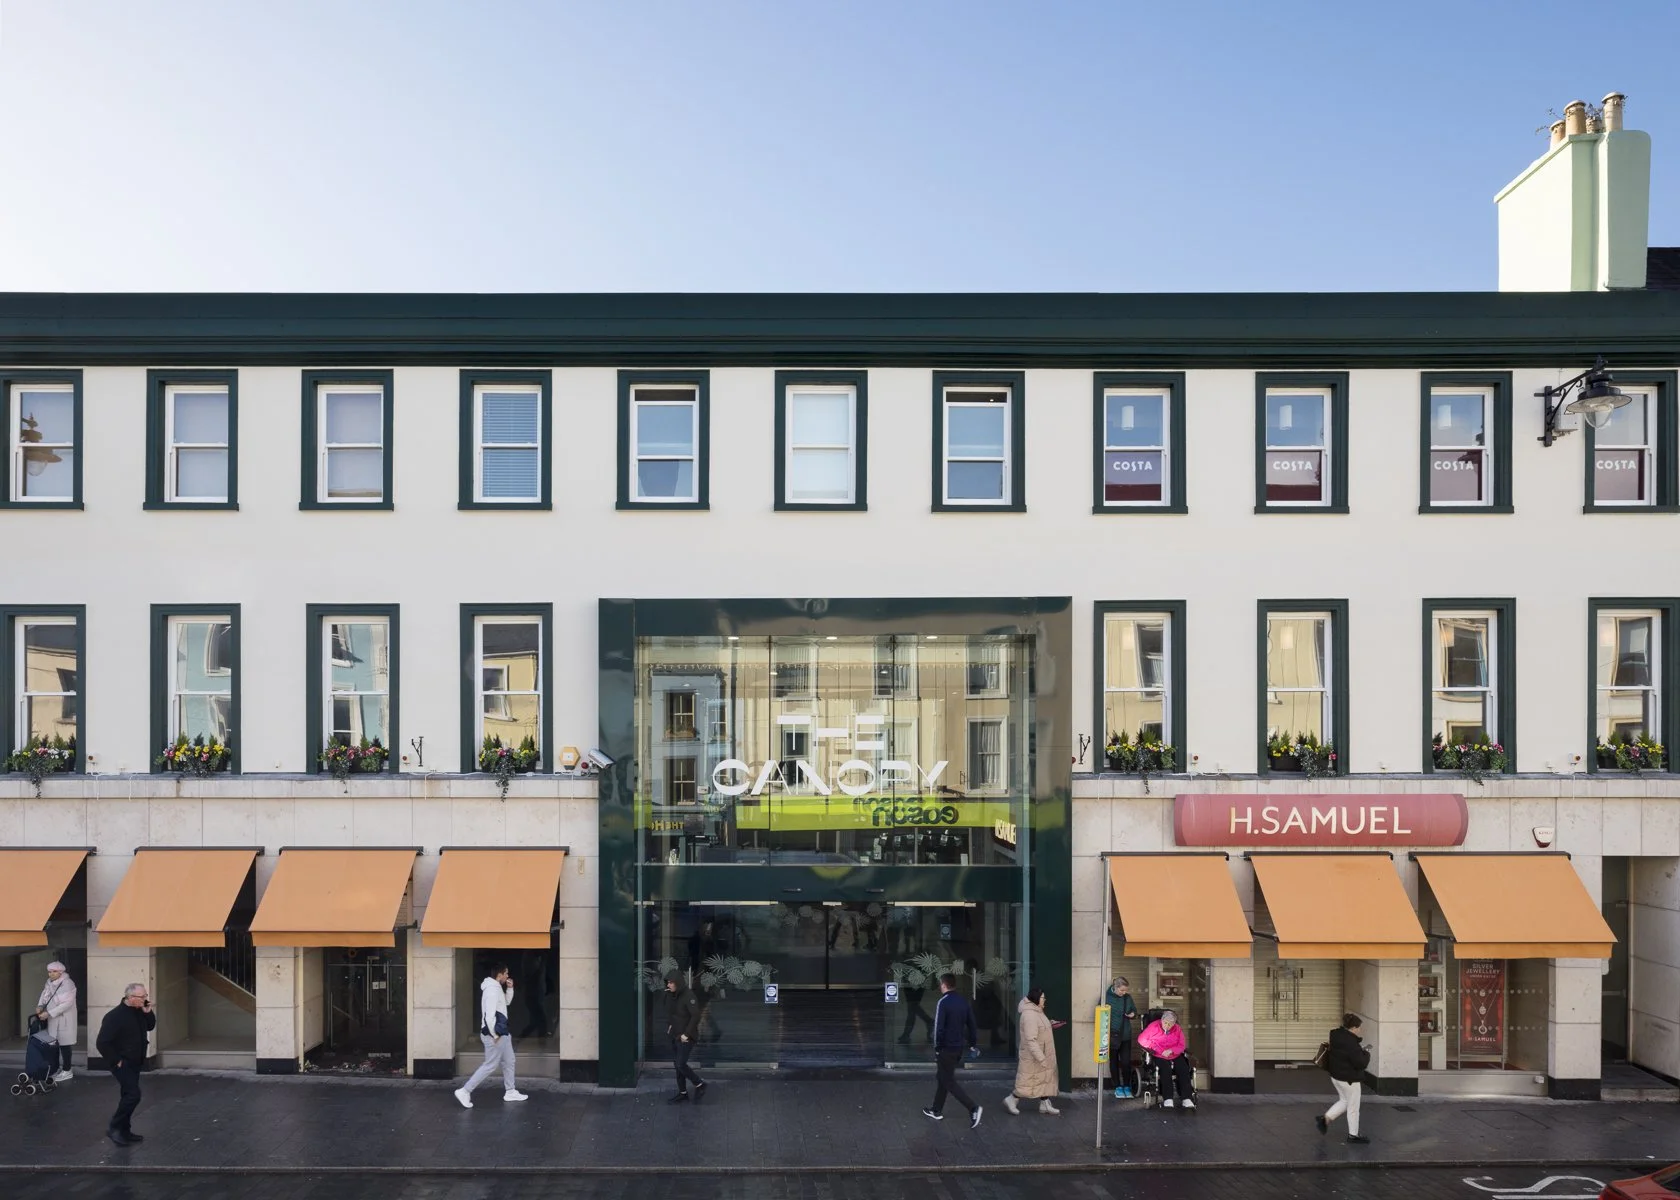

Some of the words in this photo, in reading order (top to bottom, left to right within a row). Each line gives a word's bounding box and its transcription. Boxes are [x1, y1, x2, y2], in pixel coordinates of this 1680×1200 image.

[1112, 460, 1153, 472] COSTA
[1272, 460, 1313, 472] COSTA
[1433, 460, 1474, 471] COSTA
[1595, 459, 1637, 471] COSTA
[777, 715, 885, 750] THE
[712, 758, 949, 796] CANOPY
[1230, 805, 1412, 835] H.SAMUEL
